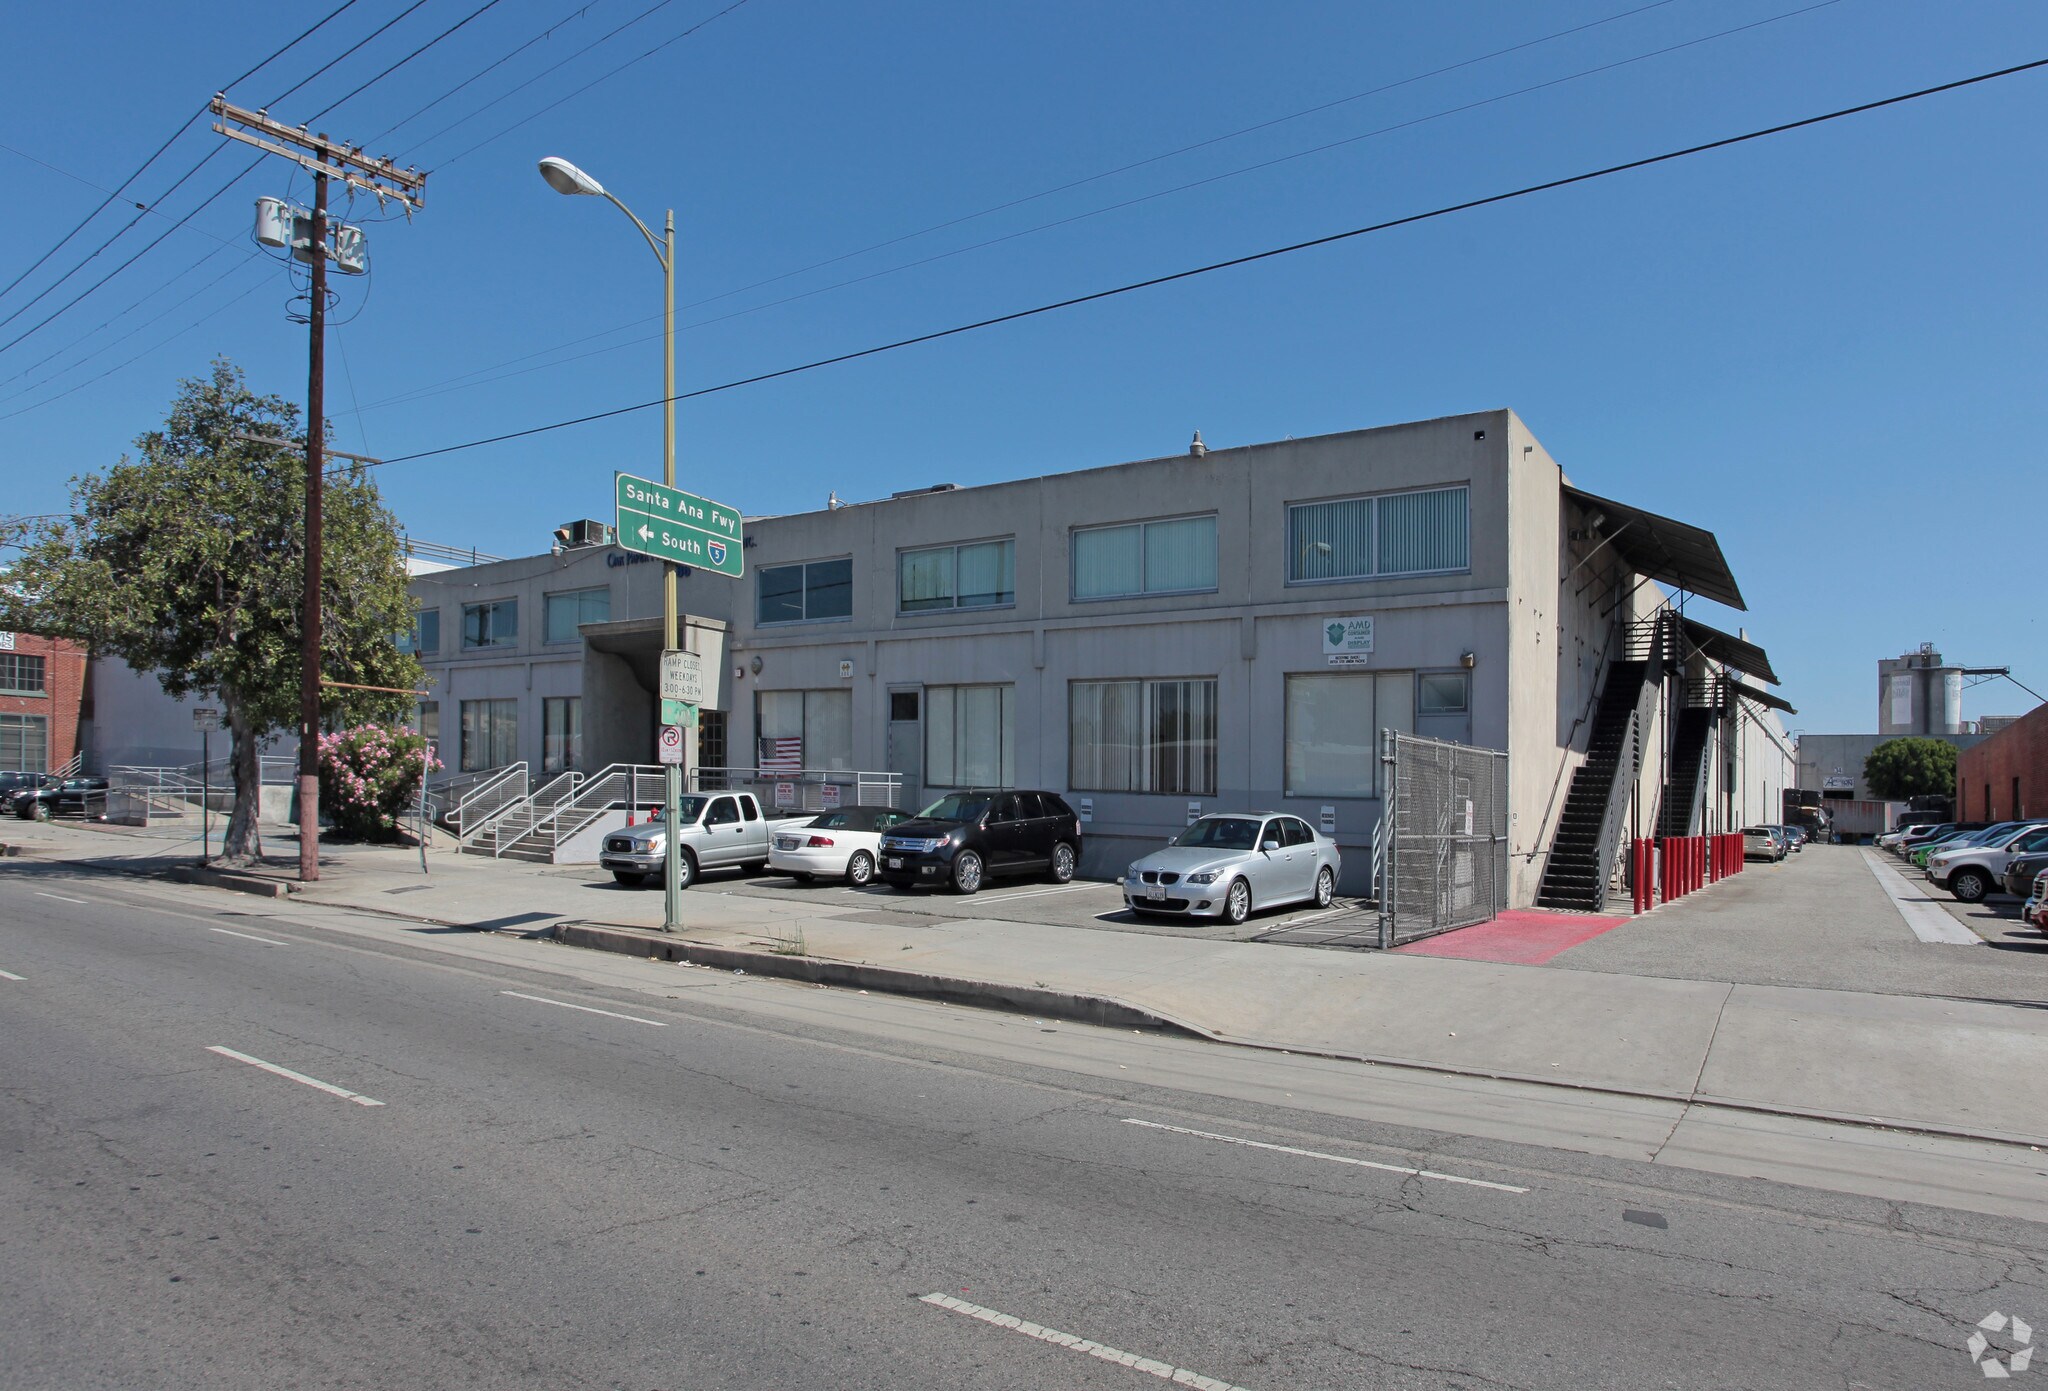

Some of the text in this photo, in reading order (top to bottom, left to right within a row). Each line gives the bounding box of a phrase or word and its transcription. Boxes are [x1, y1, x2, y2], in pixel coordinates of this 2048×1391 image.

[626, 484, 735, 534] Santa Ana Fwy
[662, 532, 701, 555] South
[714, 550, 720, 559] 5
[1348, 620, 1370, 630] AMD
[664, 656, 681, 668] RAMP
[670, 670, 698, 683] WEEKDAYS
[694, 686, 701, 697] PM
